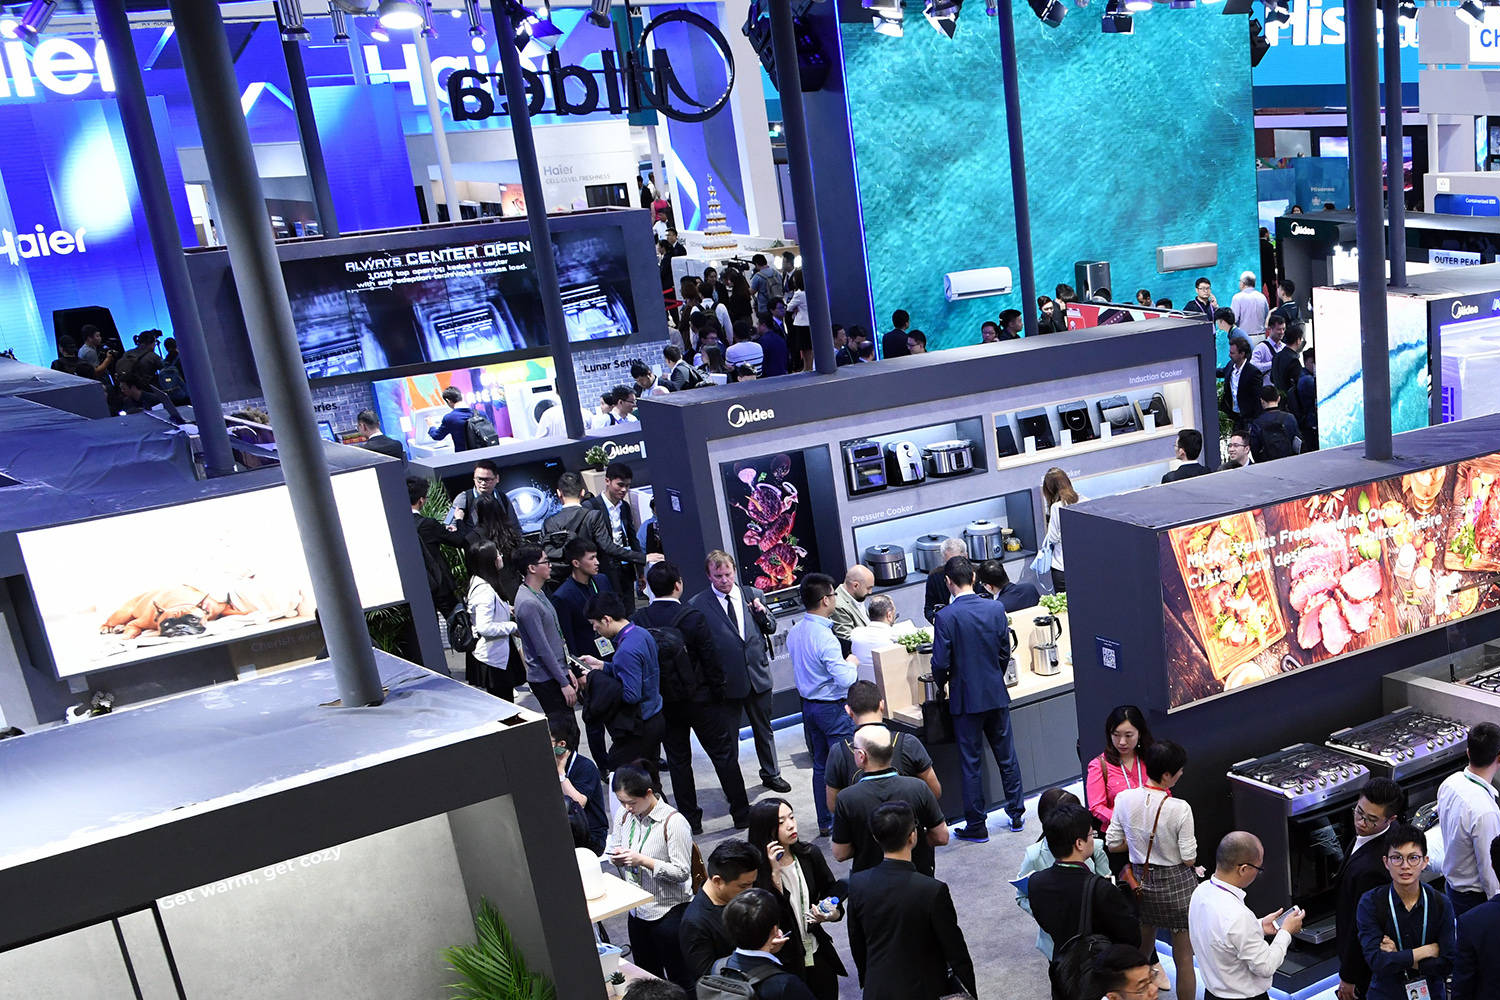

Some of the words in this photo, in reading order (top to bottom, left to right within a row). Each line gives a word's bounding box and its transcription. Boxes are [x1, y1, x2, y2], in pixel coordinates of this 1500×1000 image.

[345, 256, 402, 273] ALWAYS
[405, 246, 477, 265] CENTER
[484, 241, 531, 257] OPEN
[1434, 255, 1459, 265] OUTER
[584, 361, 612, 373] Lunar
[1129, 372, 1160, 385] Induction
[1160, 368, 1183, 381] Cooker
[727, 404, 775, 428] Midea
[602, 440, 641, 460] Midea
[852, 510, 885, 524] Pressure
[887, 504, 915, 518] Cooker
[160, 890, 196, 910] Get
[198, 876, 260, 899] warm,
[263, 860, 295, 882] get
[299, 846, 342, 869] cozy
